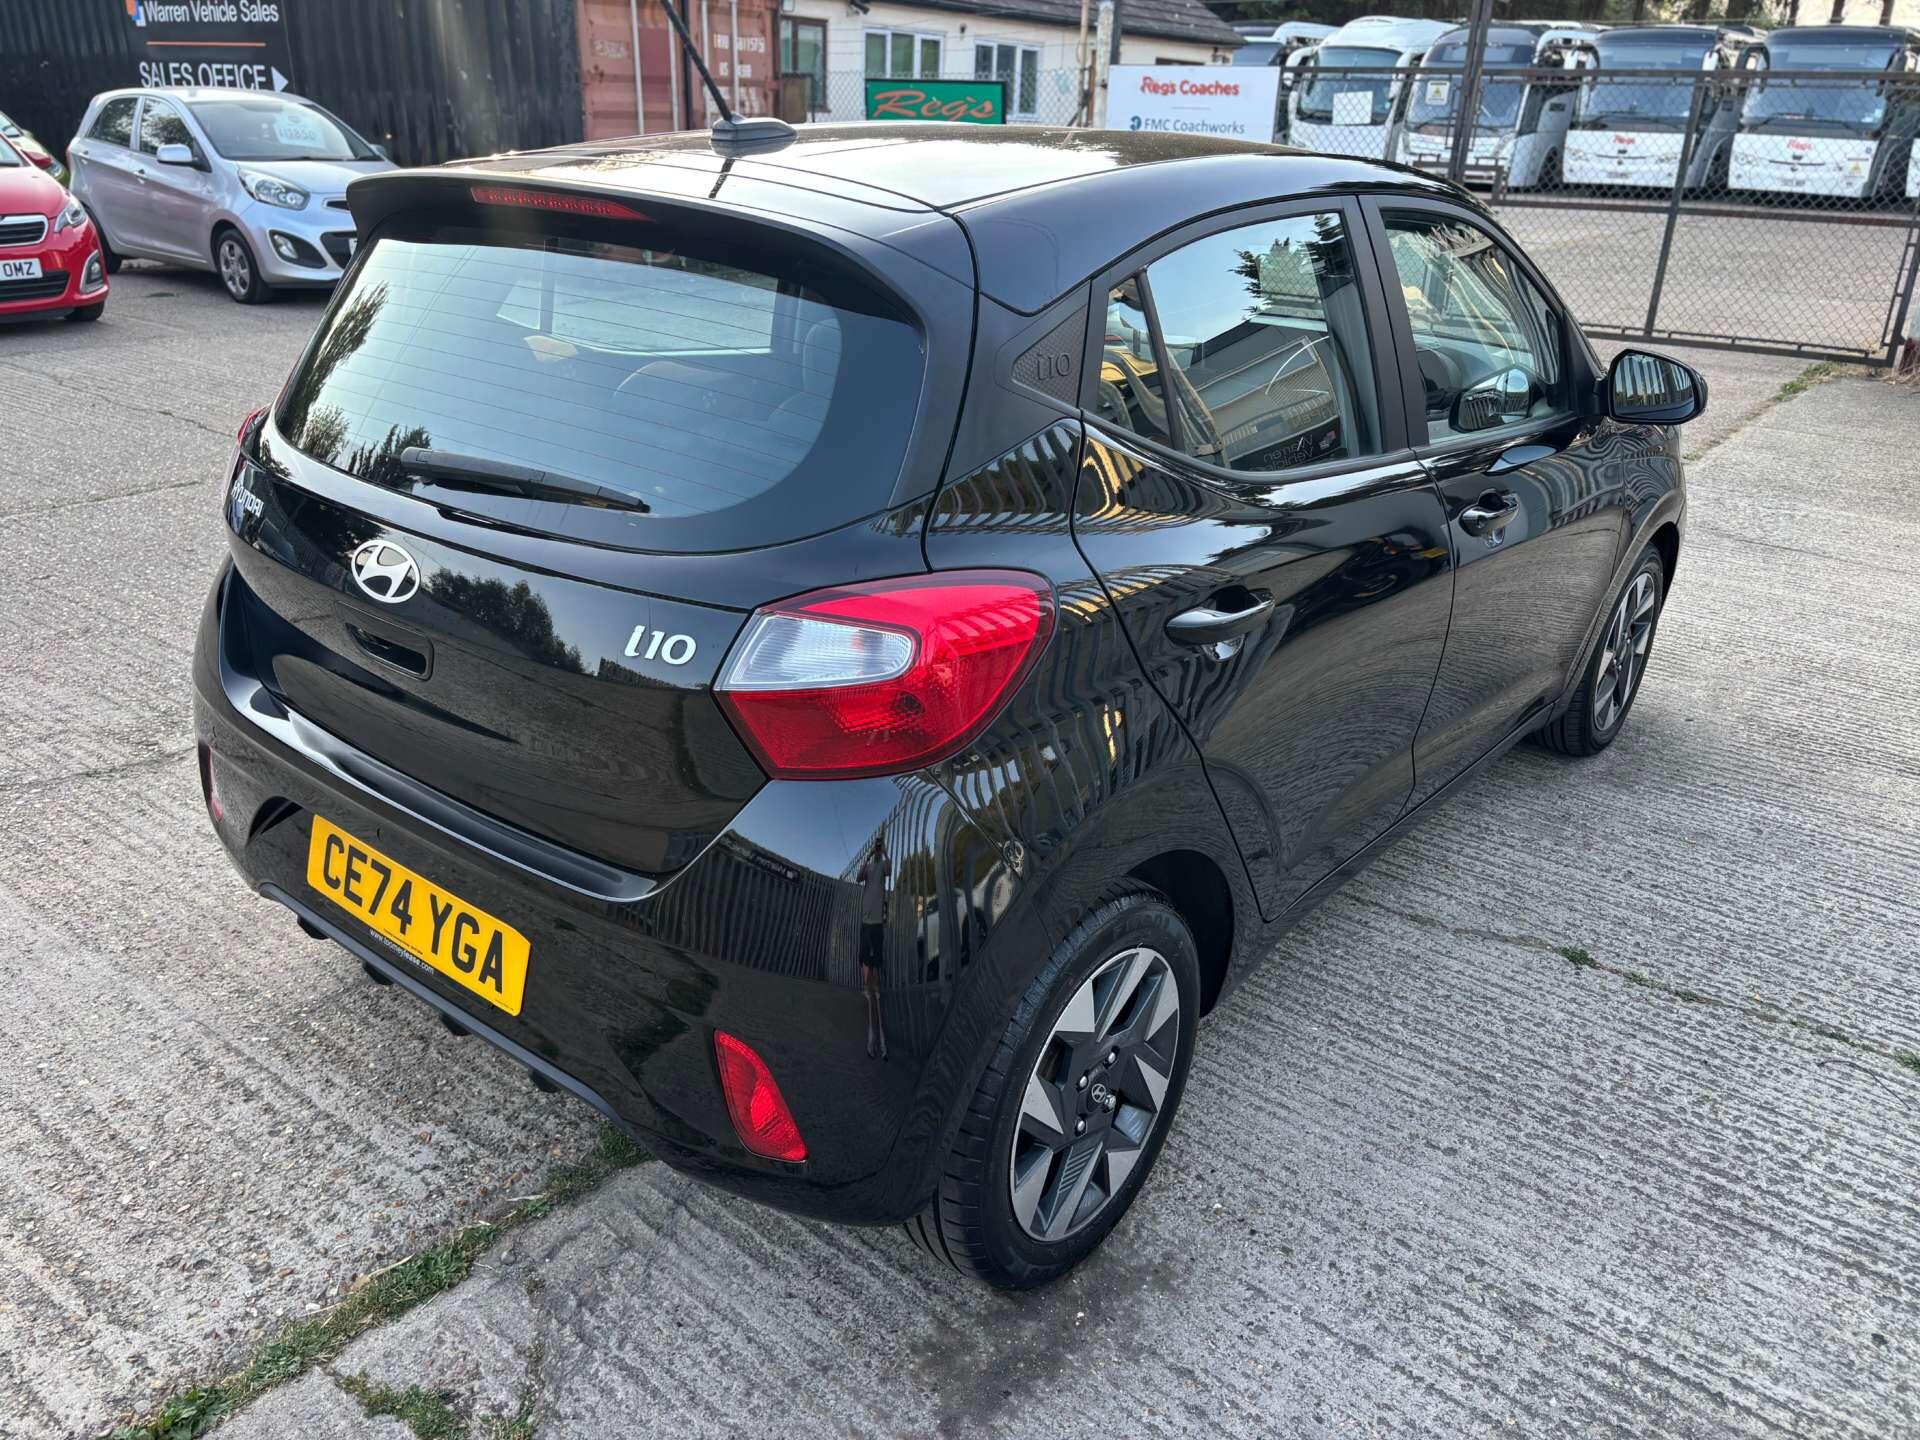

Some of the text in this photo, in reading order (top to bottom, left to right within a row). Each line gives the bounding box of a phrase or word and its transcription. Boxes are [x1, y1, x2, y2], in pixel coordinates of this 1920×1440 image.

[145, 0, 279, 22] Warren Vehicle Sales
[139, 61, 266, 90] SALES OFFICE
[1180, 80, 1240, 96] Coaches
[1144, 118, 1245, 134] FMC Coachworks
[3, 261, 36, 278] OMZ
[230, 479, 265, 518] HYUNDAI
[322, 833, 503, 995] CE74 YGA
